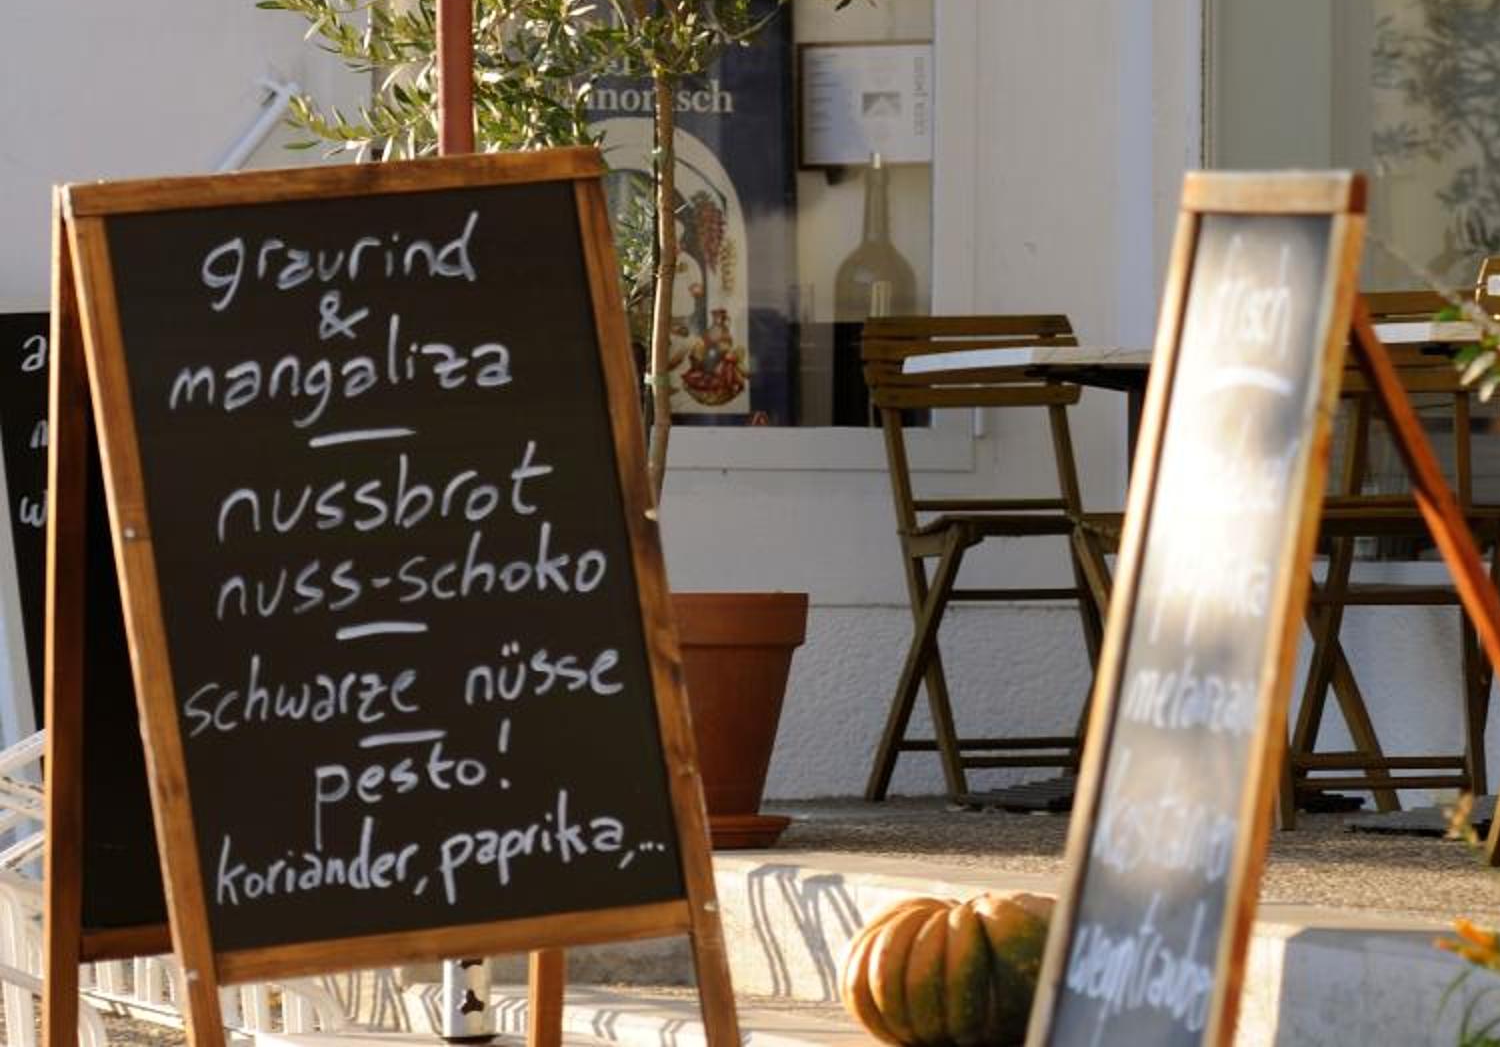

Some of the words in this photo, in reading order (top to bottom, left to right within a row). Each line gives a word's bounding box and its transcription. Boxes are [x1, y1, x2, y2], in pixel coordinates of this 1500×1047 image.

[201, 211, 479, 311] graurind
[319, 290, 369, 339] &
[169, 314, 512, 427] mangaliza
[219, 441, 553, 542] nussbrot
[218, 522, 607, 620] nuss-schoko
[184, 655, 421, 736] schwarze
[465, 643, 624, 704] nüsse
[315, 719, 510, 851] pesto!
[217, 817, 428, 904] koriander,
